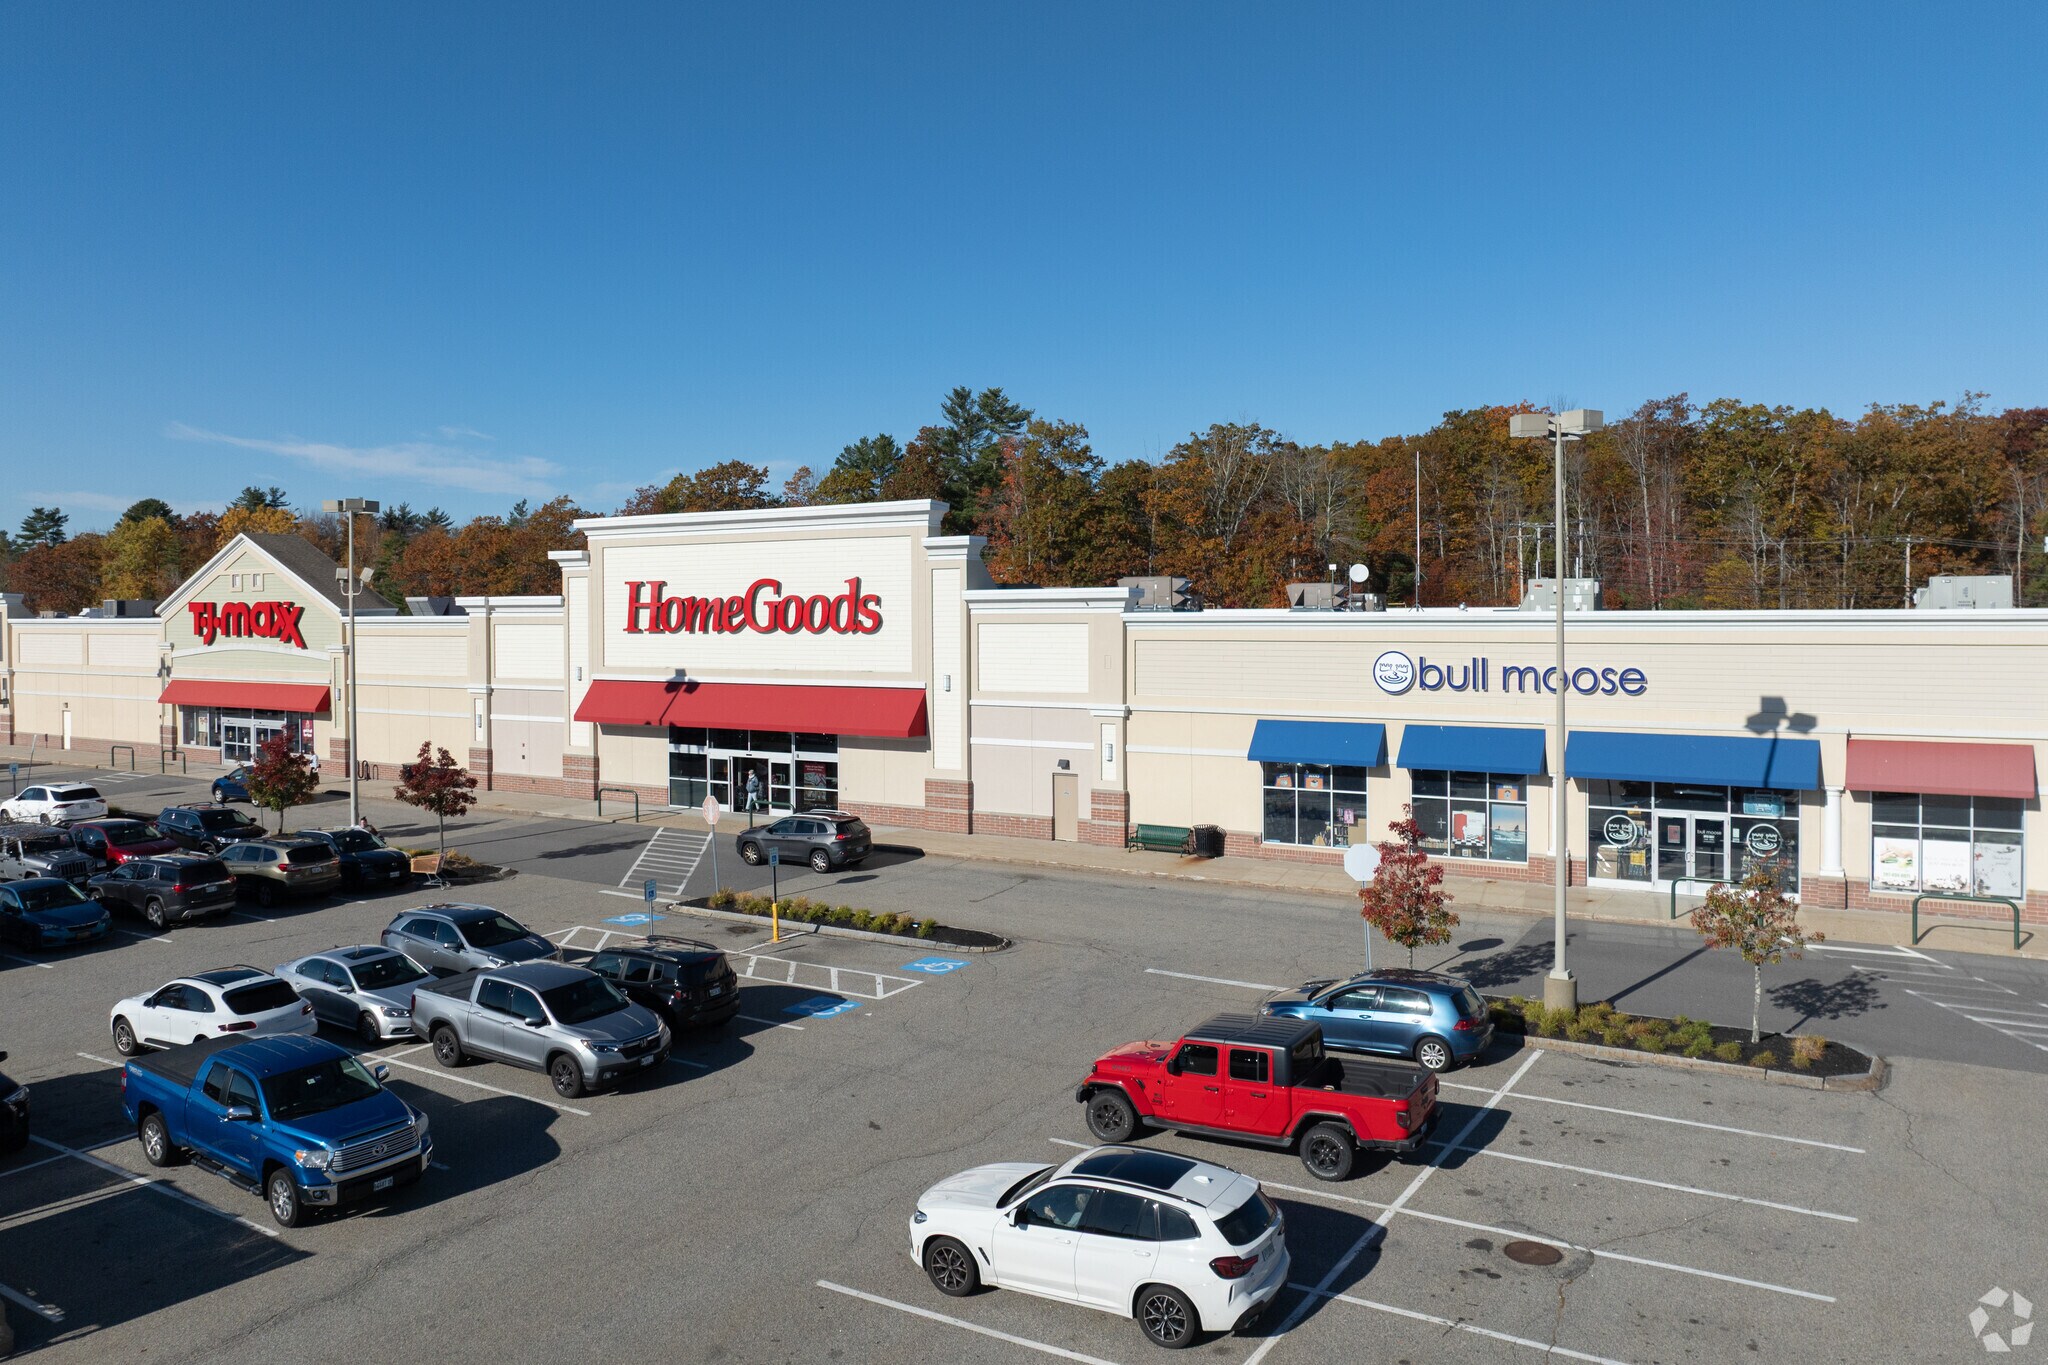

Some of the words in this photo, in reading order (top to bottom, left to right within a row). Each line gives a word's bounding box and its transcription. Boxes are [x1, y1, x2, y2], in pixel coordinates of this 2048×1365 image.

[623, 577, 881, 633] HomeGoods
[1419, 656, 1488, 693] bull
[1502, 665, 1648, 696] moose
